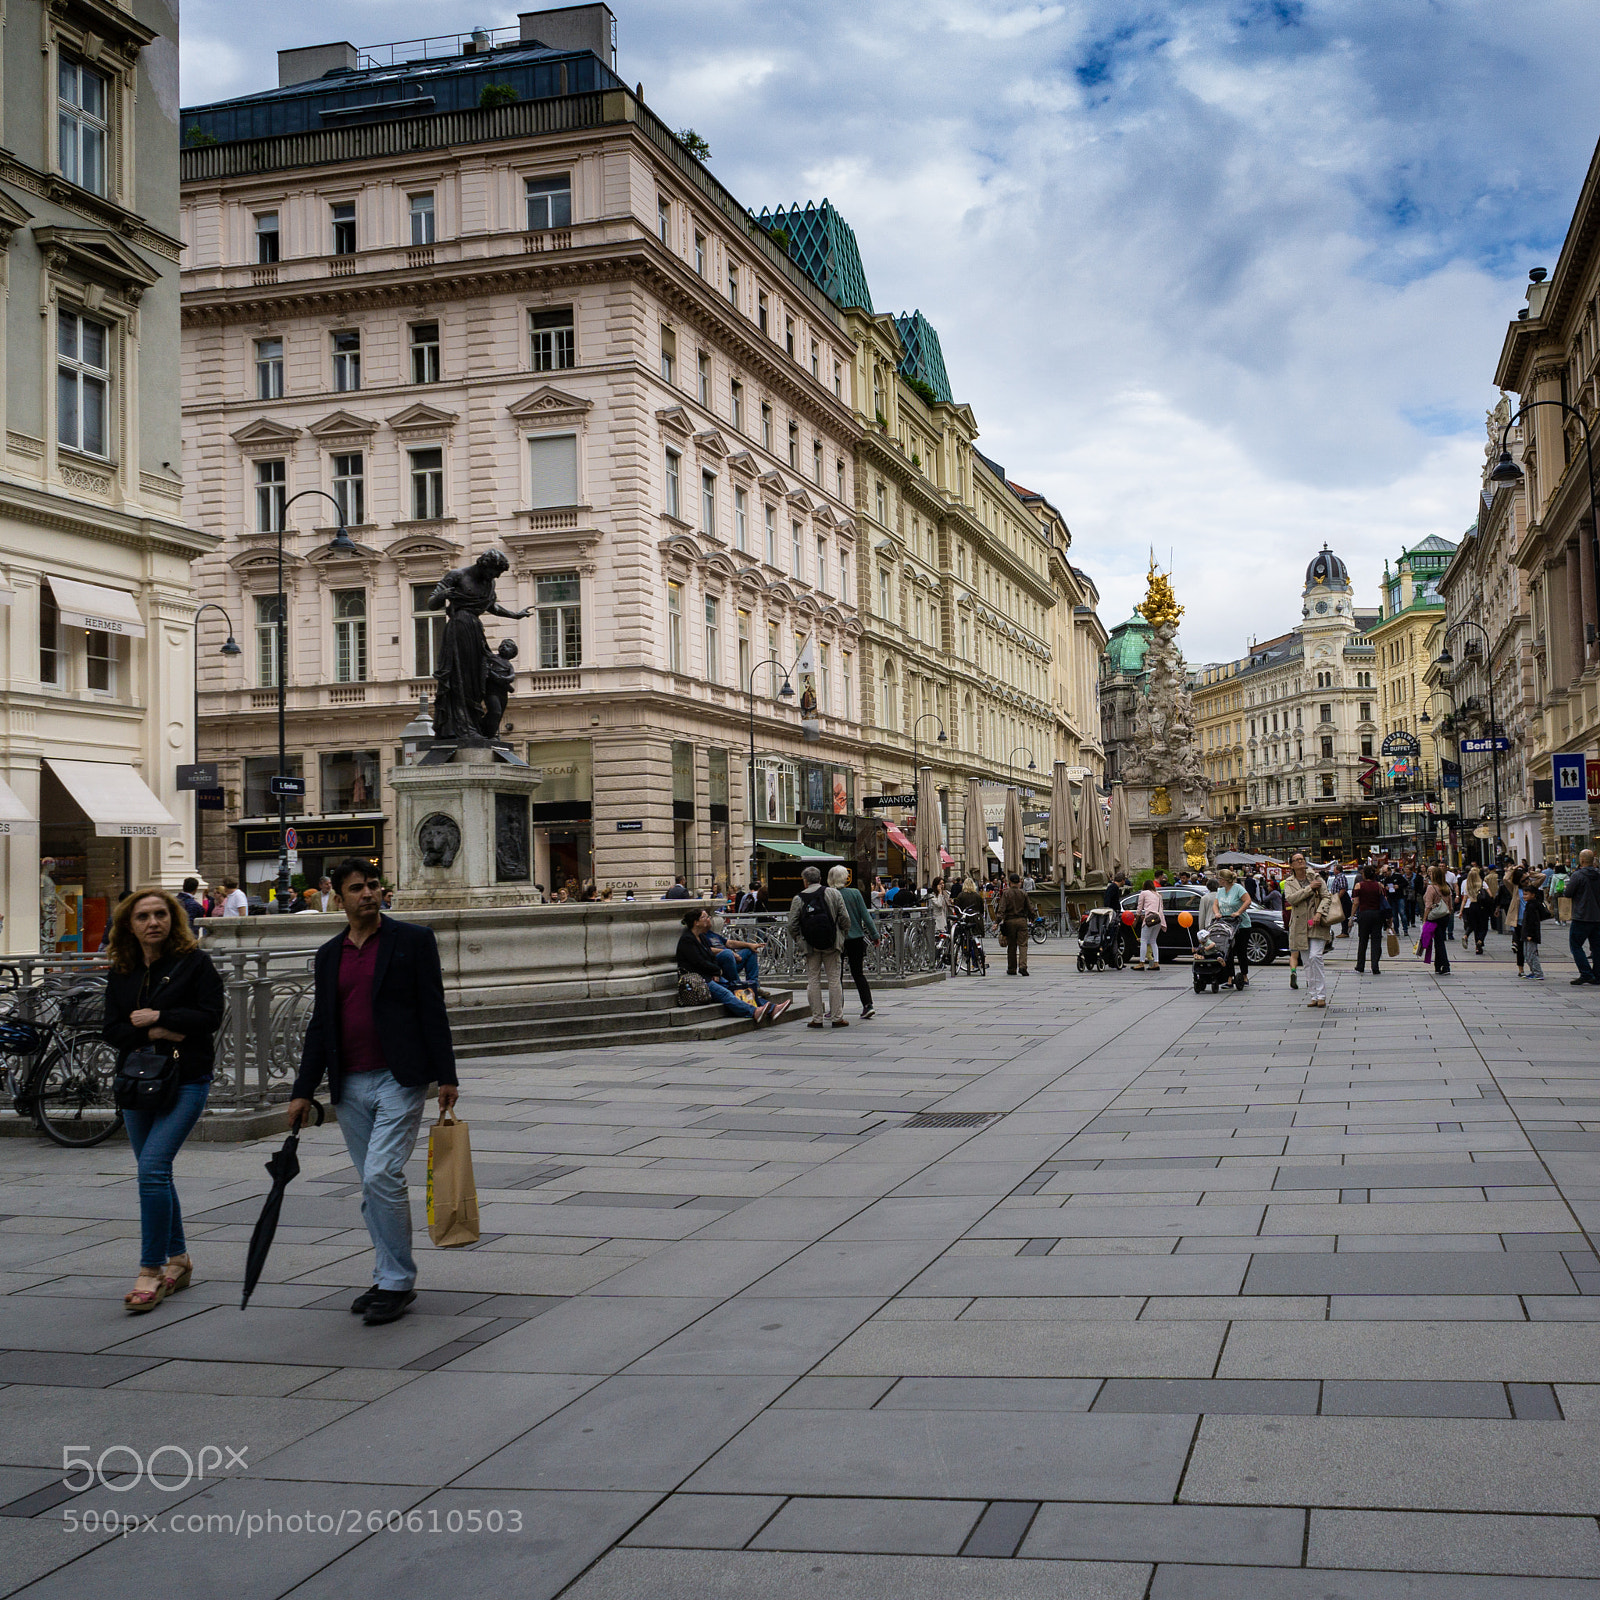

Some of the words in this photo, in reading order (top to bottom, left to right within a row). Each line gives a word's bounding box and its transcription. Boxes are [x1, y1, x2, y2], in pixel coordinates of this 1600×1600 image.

[1466, 740, 1503, 750] Berliz
[541, 766, 580, 775] ESCADA
[879, 796, 917, 804] AVANTGA
[296, 833, 349, 846] ARFUM
[605, 881, 639, 889] ESCADA
